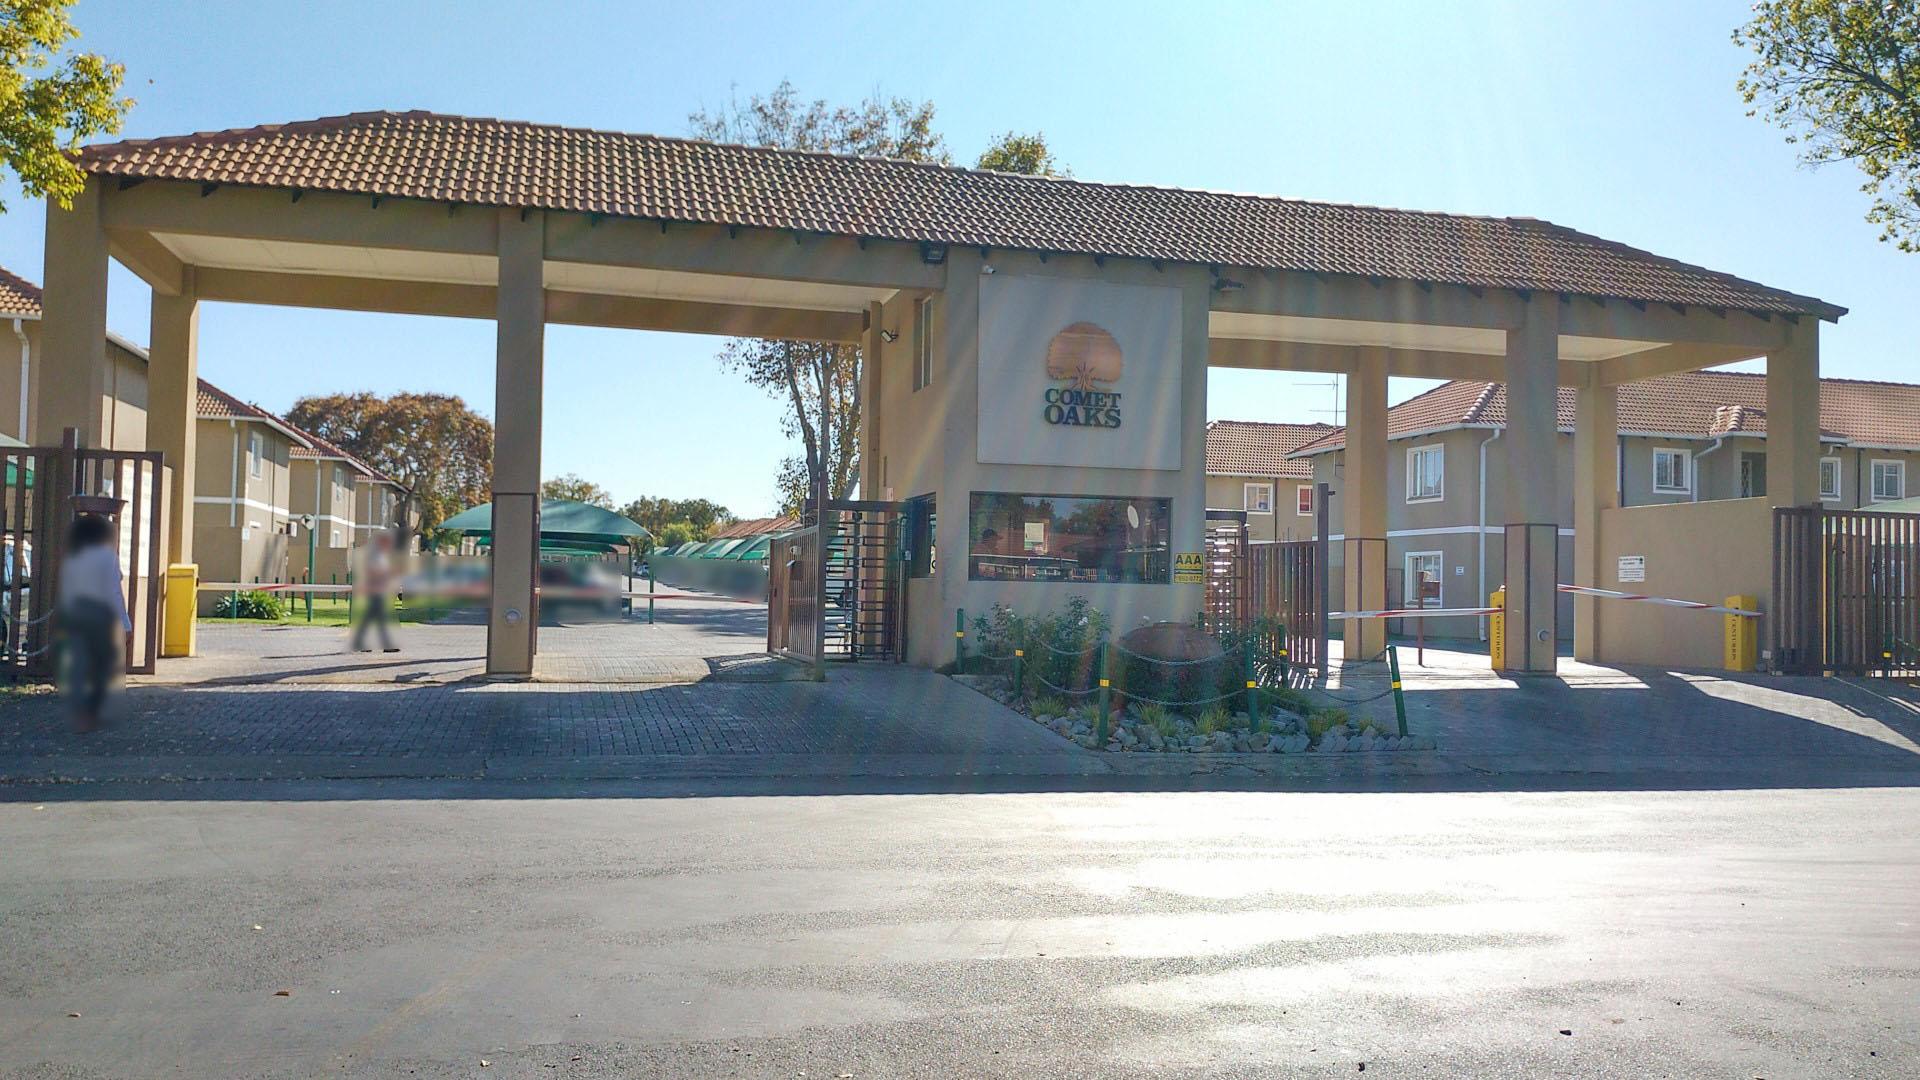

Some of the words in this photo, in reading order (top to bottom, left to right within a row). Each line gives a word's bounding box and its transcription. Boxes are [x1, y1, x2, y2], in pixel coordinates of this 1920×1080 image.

[1044, 388, 1121, 408] COMET
[1044, 404, 1121, 428] OAKS
[1176, 555, 1202, 564] AAA
